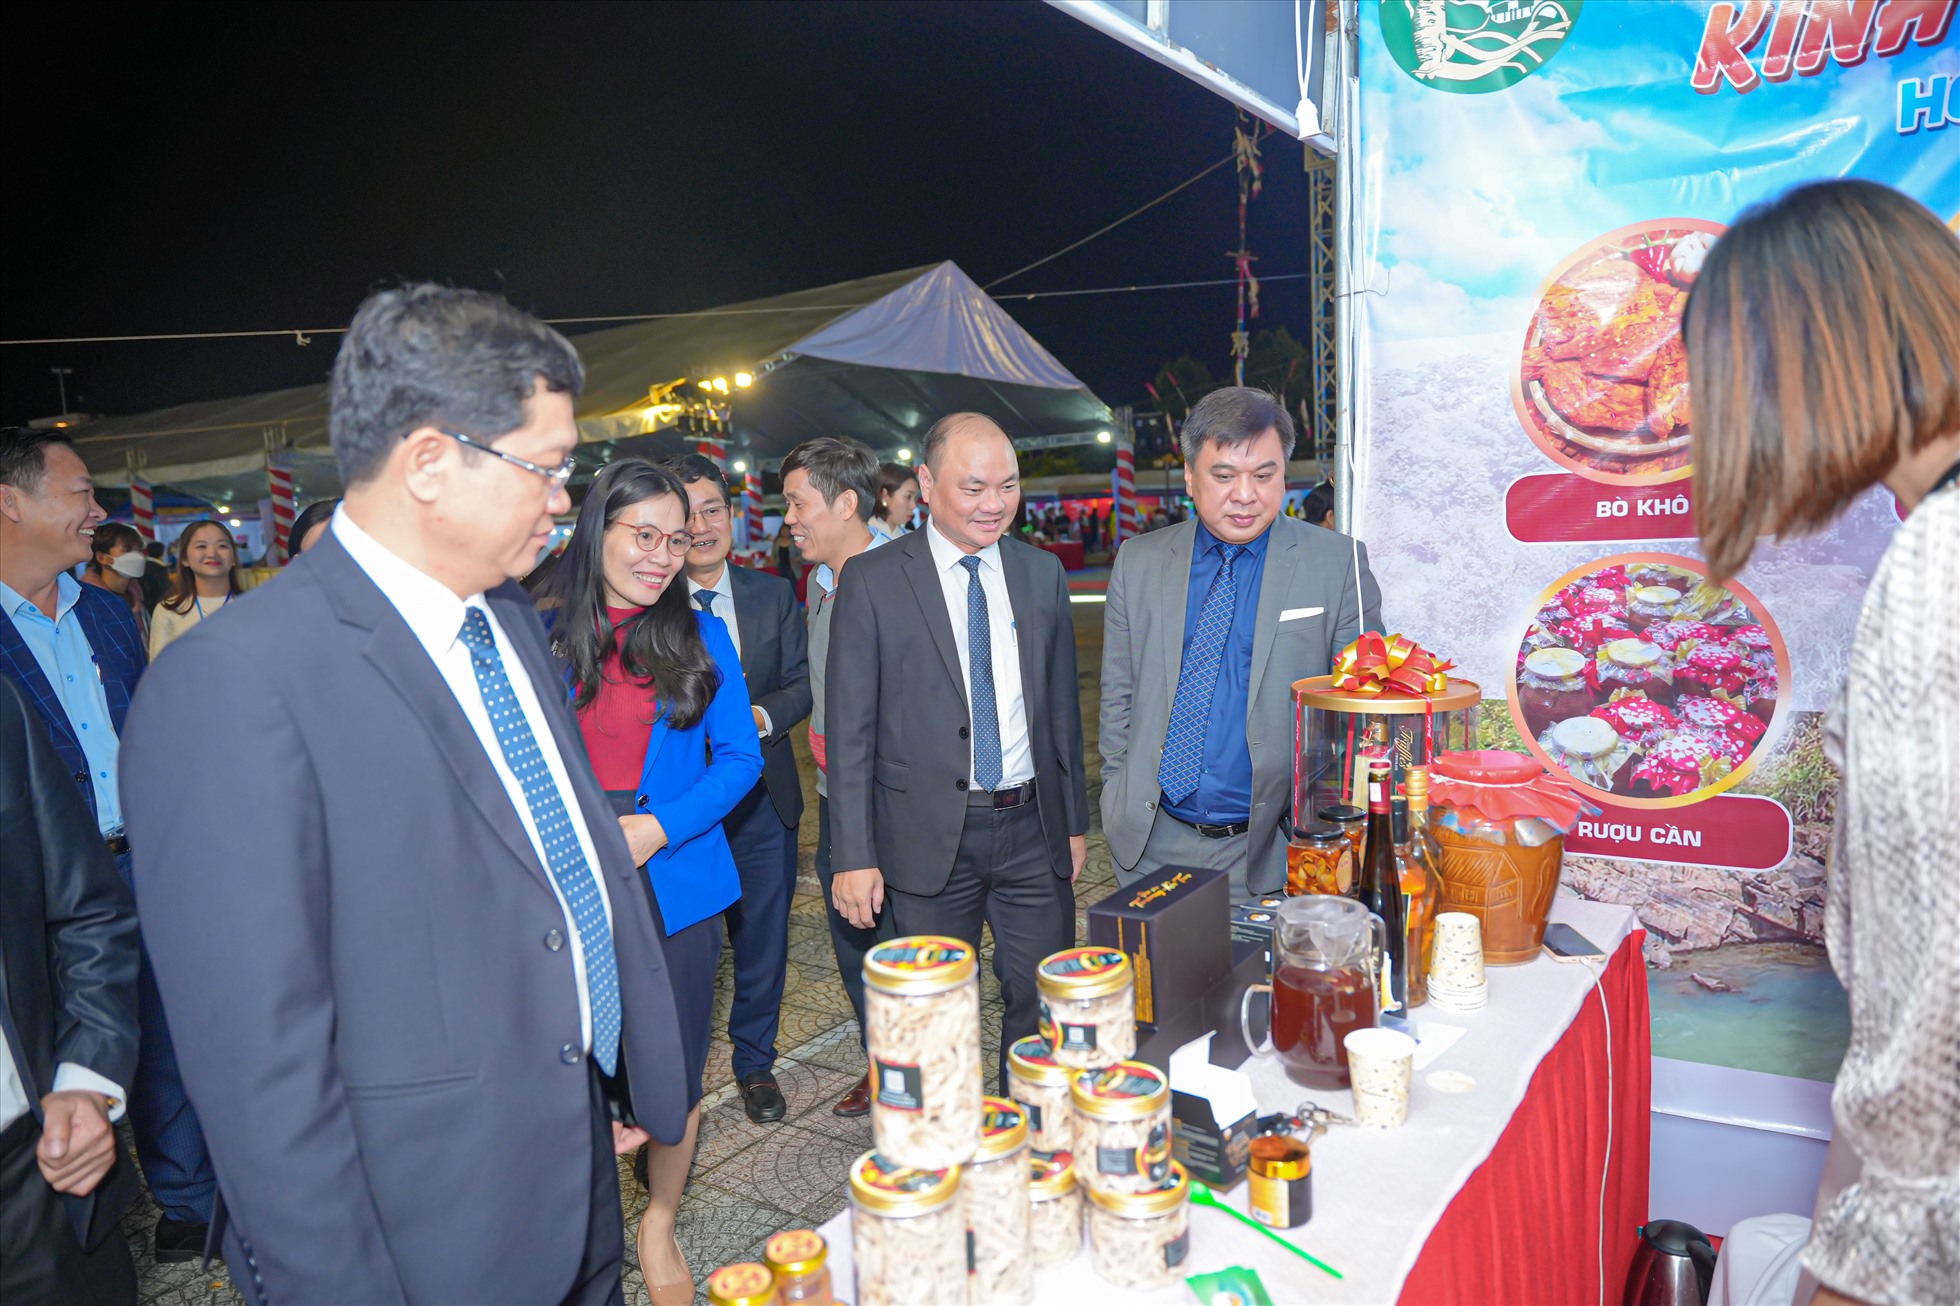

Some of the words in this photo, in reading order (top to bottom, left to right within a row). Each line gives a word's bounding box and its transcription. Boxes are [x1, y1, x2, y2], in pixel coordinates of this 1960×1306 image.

[1596, 496, 1629, 518] BÒ
[1637, 493, 1689, 516] KHÔ
[1578, 821, 1642, 844] RƯỢU
[1650, 823, 1702, 847] CẦN
